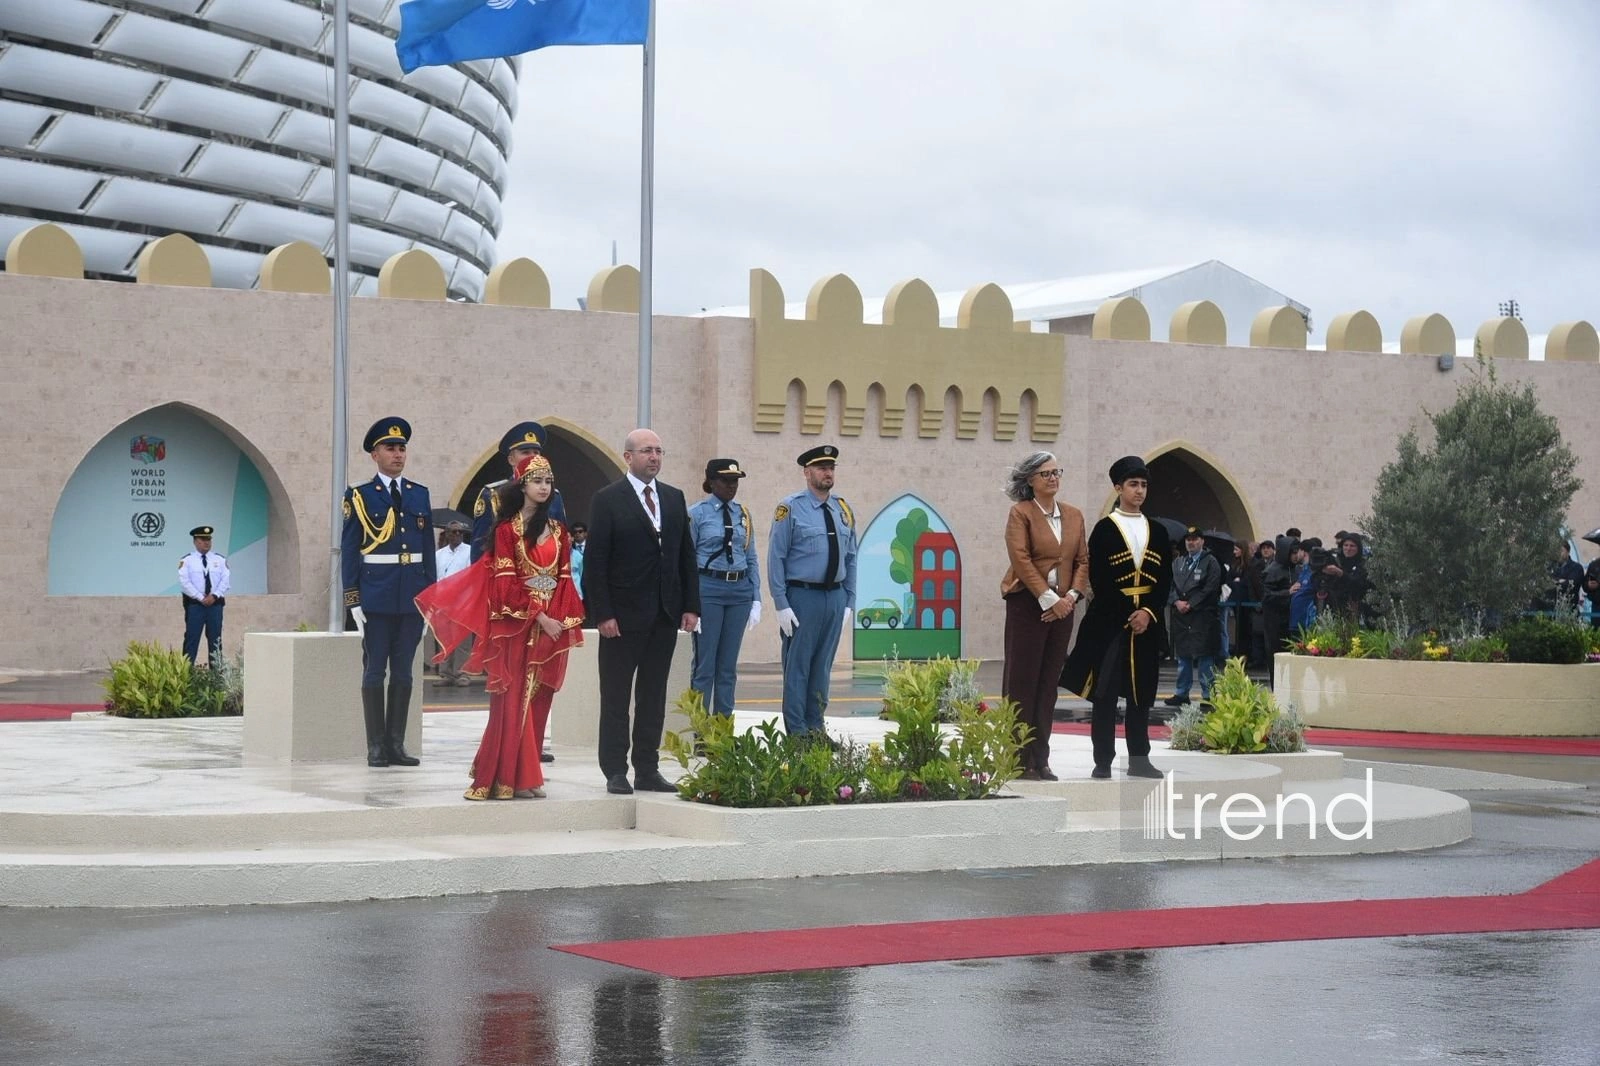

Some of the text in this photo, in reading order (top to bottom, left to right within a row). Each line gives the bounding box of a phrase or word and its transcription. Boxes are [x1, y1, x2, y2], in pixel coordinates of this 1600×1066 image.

[130, 469, 166, 477] WORLD
[130, 479, 166, 487] URBAN
[130, 488, 166, 497] FORUM
